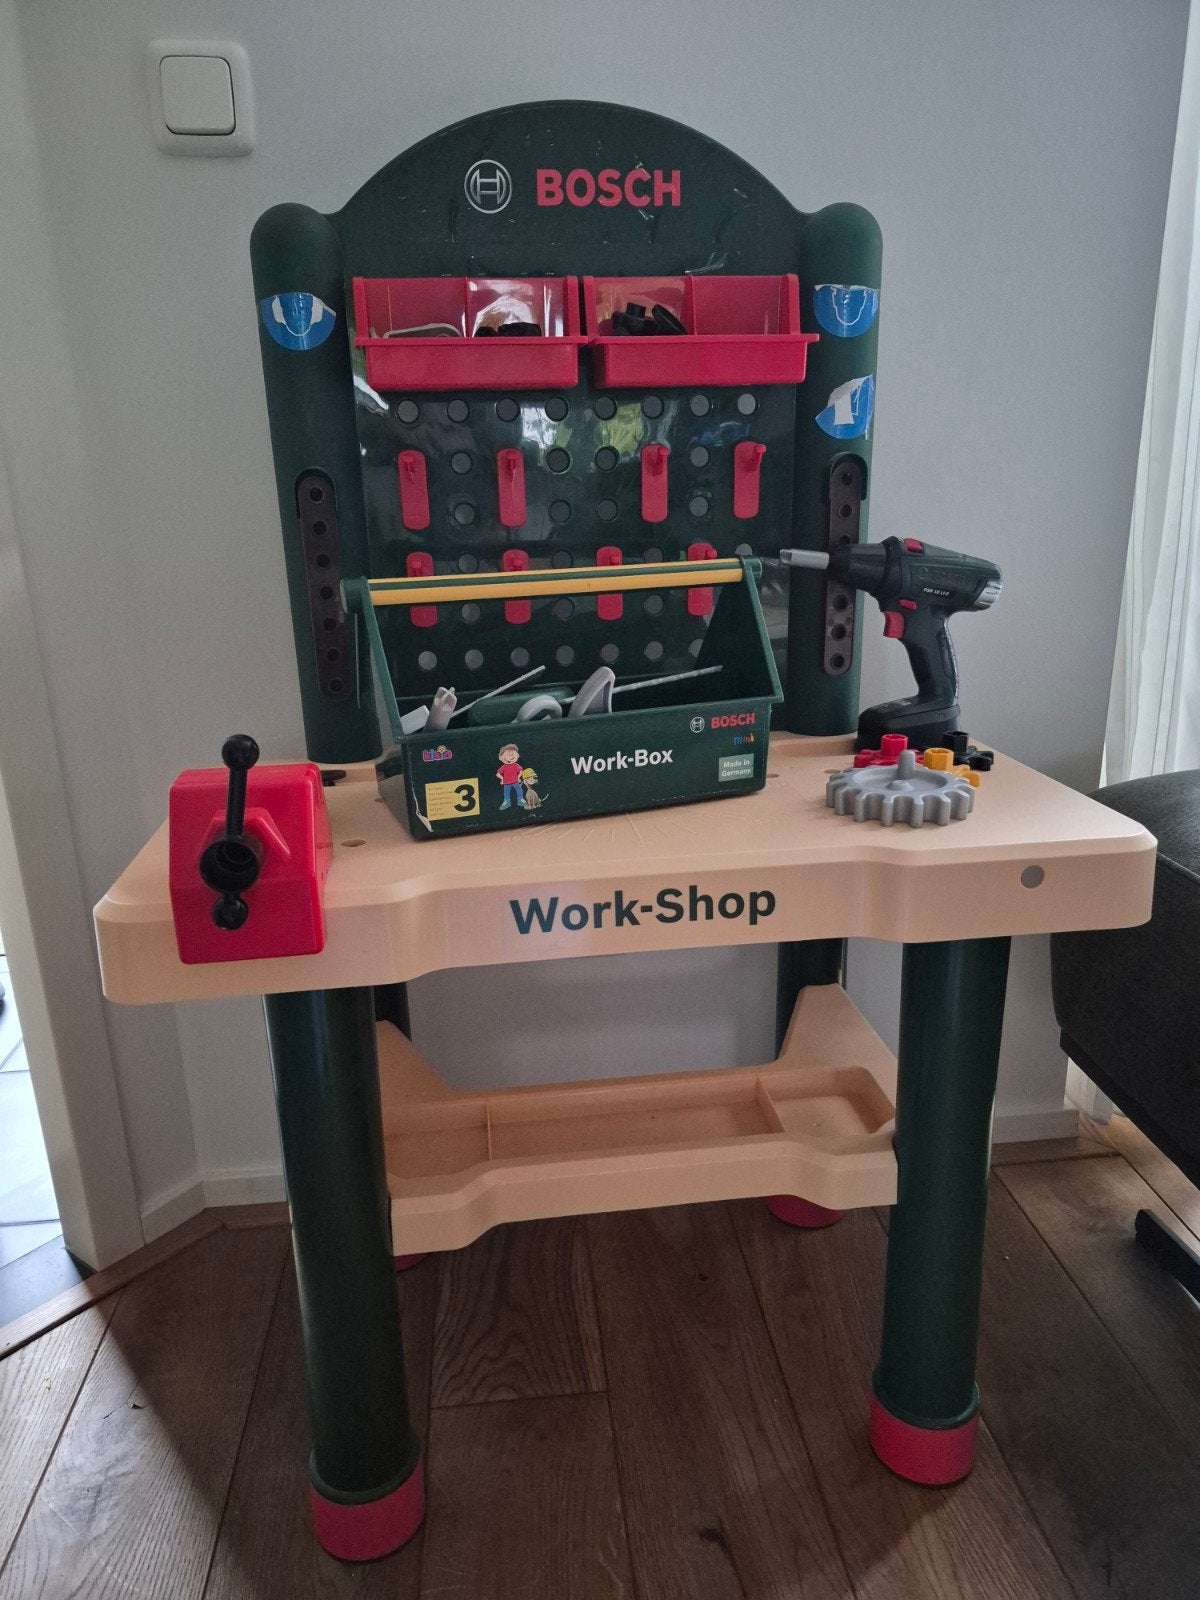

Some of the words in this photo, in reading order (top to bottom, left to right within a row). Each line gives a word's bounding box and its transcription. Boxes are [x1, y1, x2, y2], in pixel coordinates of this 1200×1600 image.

[536, 169, 681, 207] BOSCH
[711, 713, 755, 729] BOSCH
[571, 749, 673, 775] Work-Box
[721, 769, 751, 777] Germany
[723, 761, 742, 769] Made
[454, 784, 476, 812] 3
[509, 885, 776, 934] Work-Shop
